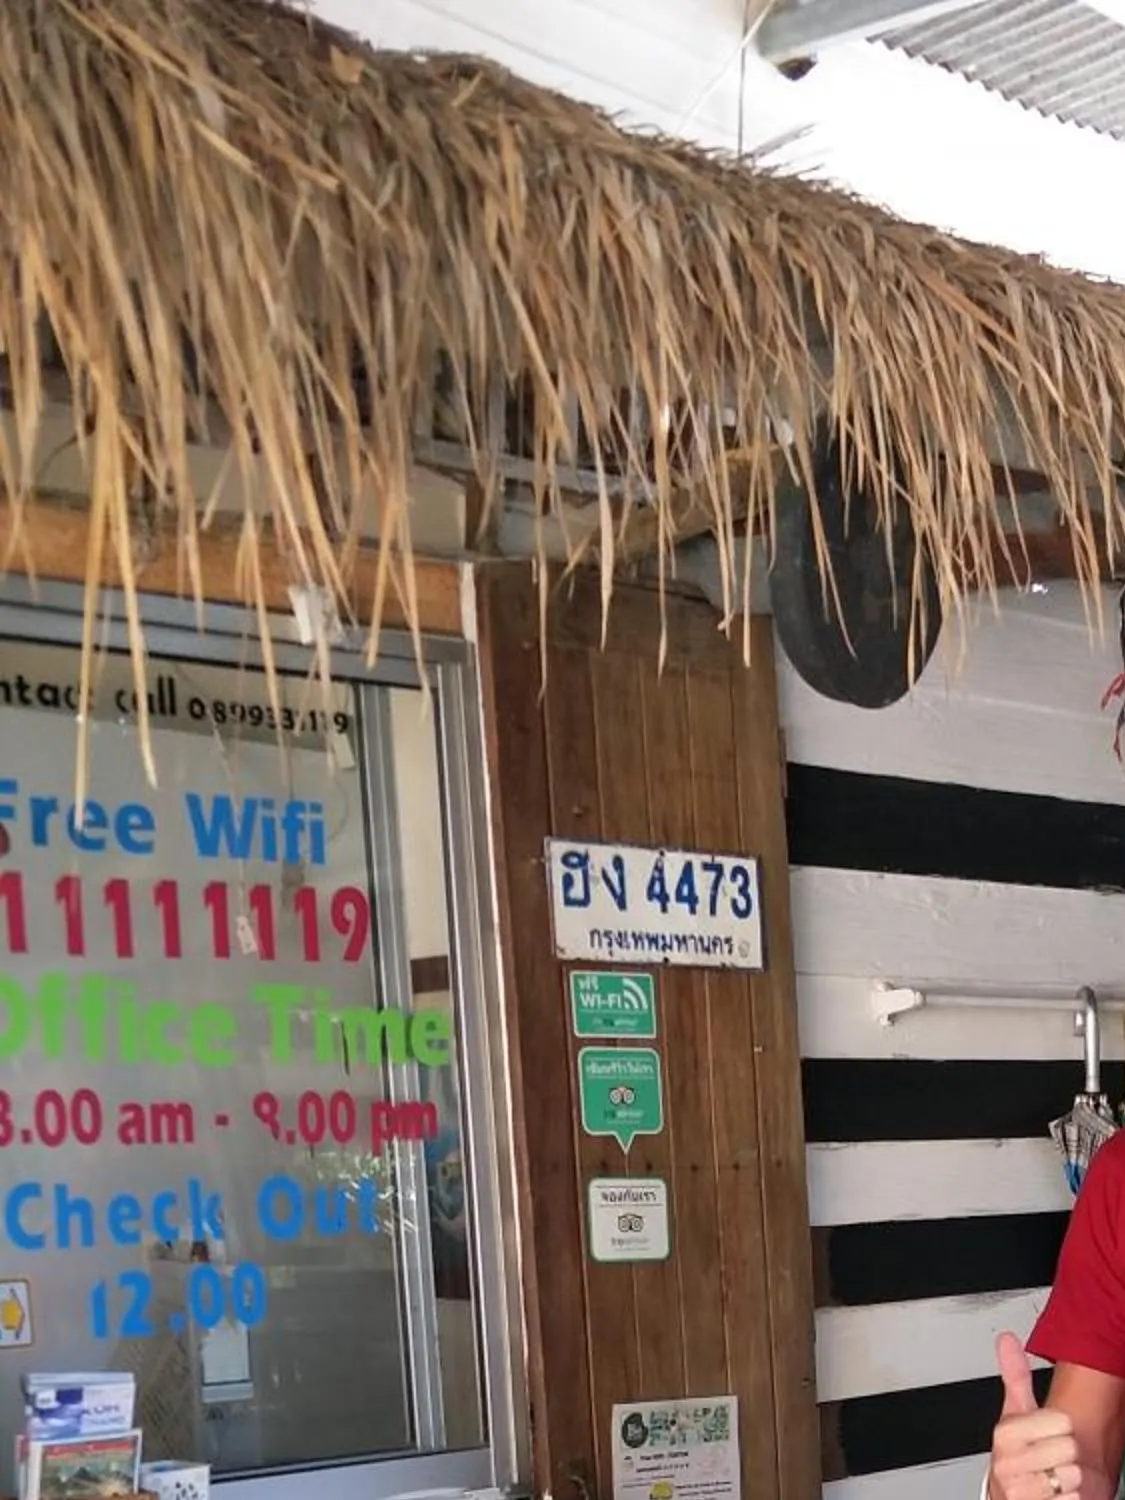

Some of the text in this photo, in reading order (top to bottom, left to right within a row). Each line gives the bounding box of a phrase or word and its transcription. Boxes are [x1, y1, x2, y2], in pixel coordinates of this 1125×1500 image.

[185, 793, 327, 866] Wifi
[646, 853, 751, 919] 4473
[589, 928, 734, 957] กรุงเทพมหานคร
[249, 984, 451, 1068] Time
[118, 1101, 194, 1145] am
[253, 1090, 356, 1146] 9.00
[371, 1101, 439, 1157] pm
[5, 1173, 377, 1251] Check Out
[90, 1260, 267, 1339] 12.00
